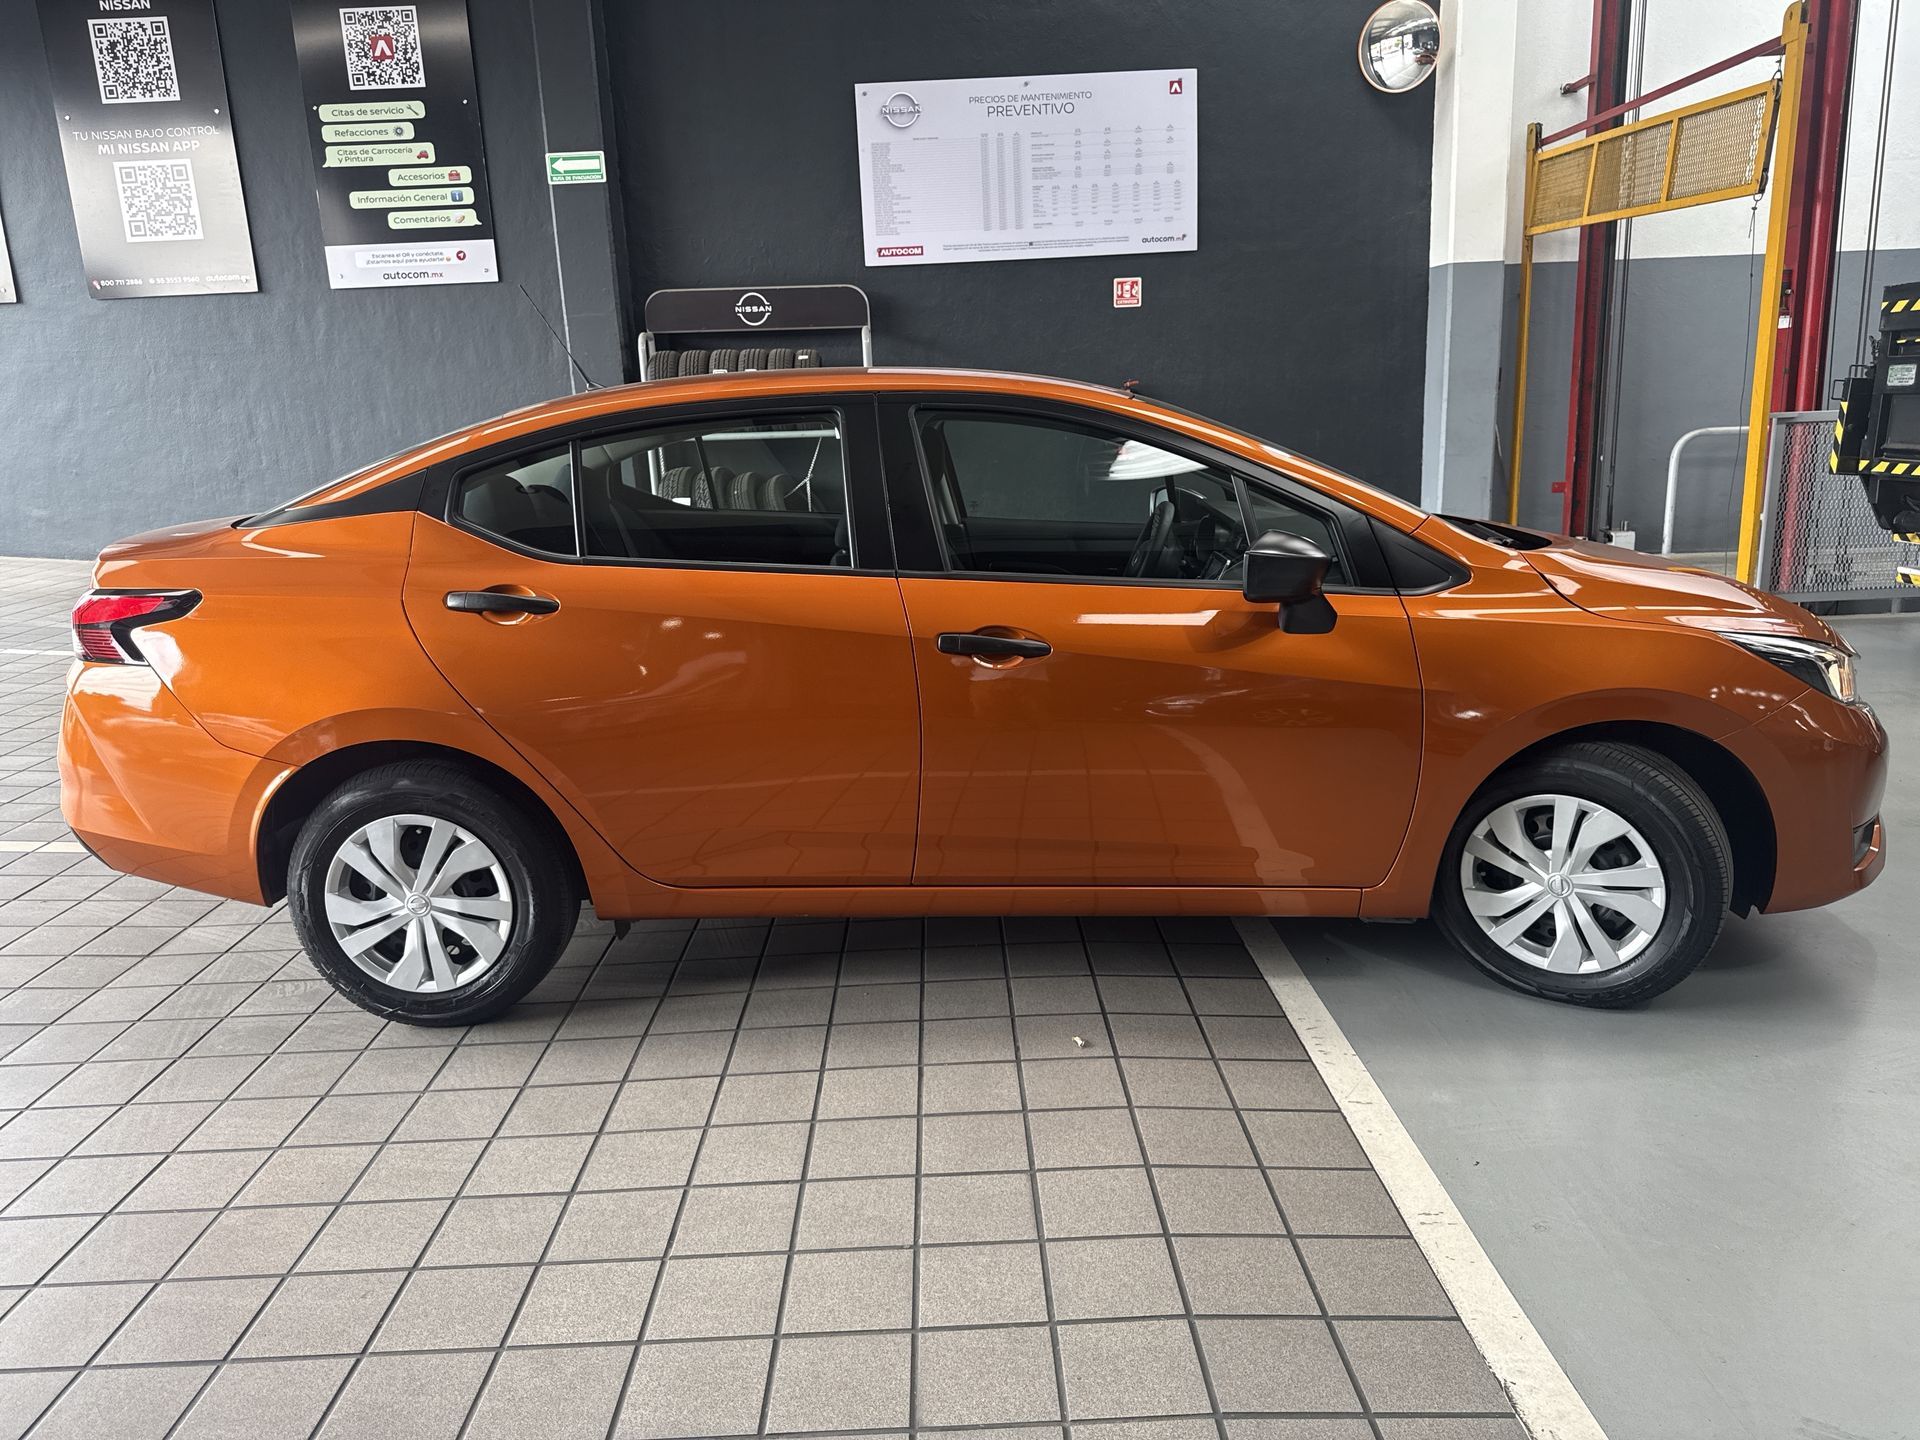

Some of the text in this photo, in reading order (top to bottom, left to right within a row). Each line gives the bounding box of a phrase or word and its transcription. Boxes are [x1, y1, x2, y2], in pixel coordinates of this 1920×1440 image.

[98, 0, 151, 11] NISSAN
[968, 91, 1093, 105] PRECIOS DE MANTENIMIENTO
[331, 107, 404, 117] Citas de servicio
[881, 105, 922, 114] NISSAN
[987, 101, 1075, 118] PREVENTIVO
[72, 125, 220, 141] TU NISSAN BAJO CONTROL
[334, 128, 389, 137] Refacciones
[98, 140, 201, 156] MI NISSAN APP
[397, 172, 446, 181] Accesorios
[357, 193, 448, 204] Información General
[393, 215, 451, 224] Comentarios
[878, 247, 923, 257] AUTOCOM
[382, 271, 444, 280] autocom.mx
[100, 279, 114, 287] 800
[735, 305, 772, 313] NISSAN
